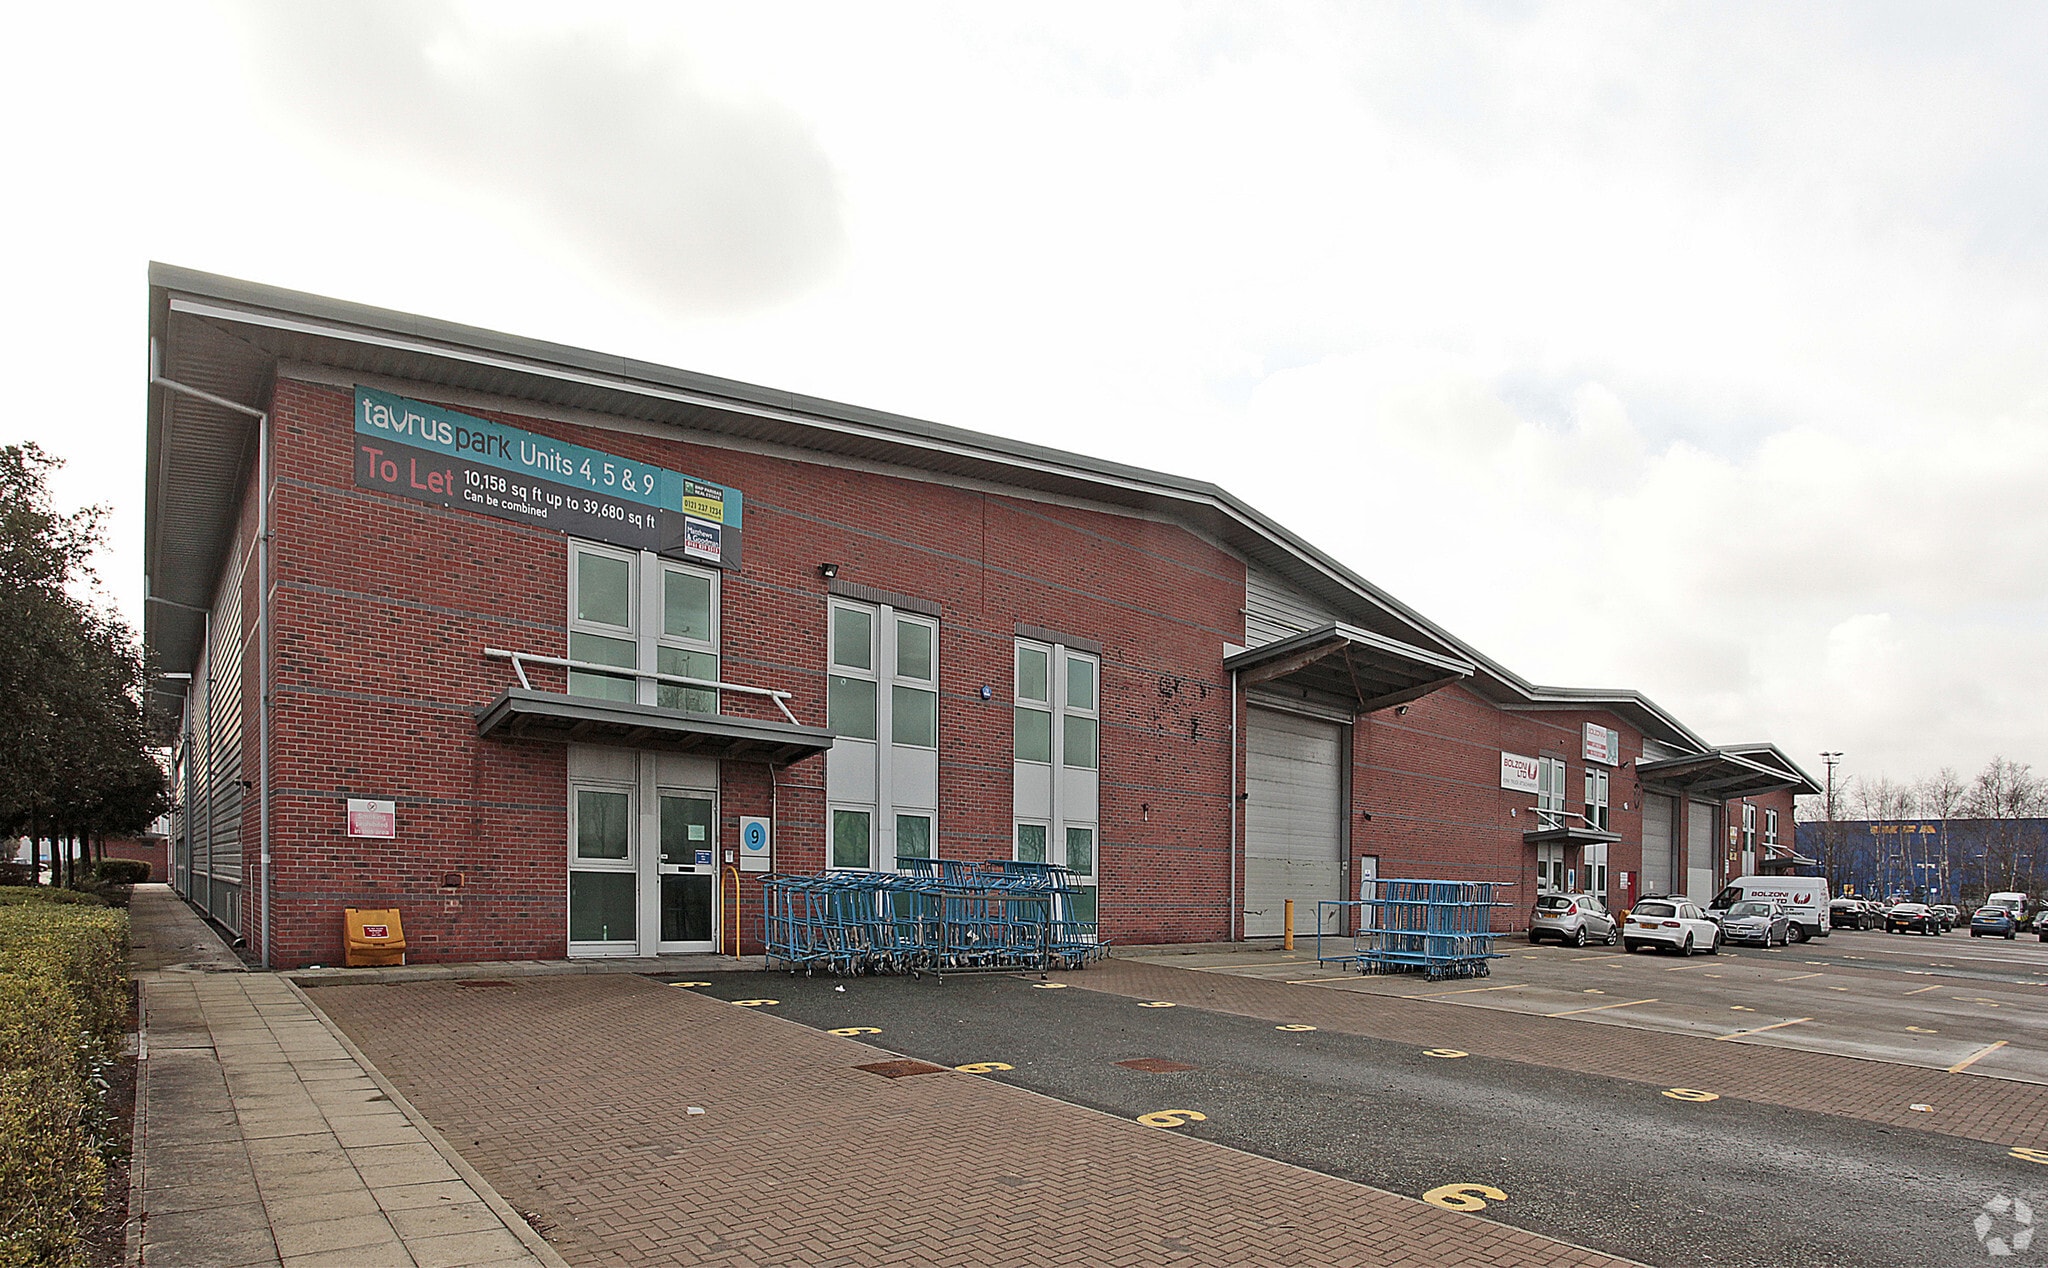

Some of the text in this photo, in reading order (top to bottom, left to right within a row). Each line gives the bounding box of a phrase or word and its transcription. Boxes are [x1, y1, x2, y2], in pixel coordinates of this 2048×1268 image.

[361, 446, 454, 496] To Let
[520, 440, 573, 476] Units
[579, 458, 596, 485] 4,
[603, 462, 615, 486] 5
[621, 468, 637, 493] &
[643, 474, 654, 496] 9
[463, 488, 548, 519] Can be combined
[464, 469, 656, 529] 10,158 sq ft up to 39,680 sq ft
[684, 499, 697, 508] 0121
[698, 503, 708, 512] 237
[709, 506, 722, 516] 1234
[1504, 758, 1528, 771] BOLZONI
[1517, 770, 1527, 779] LTD
[751, 829, 759, 844] 9
